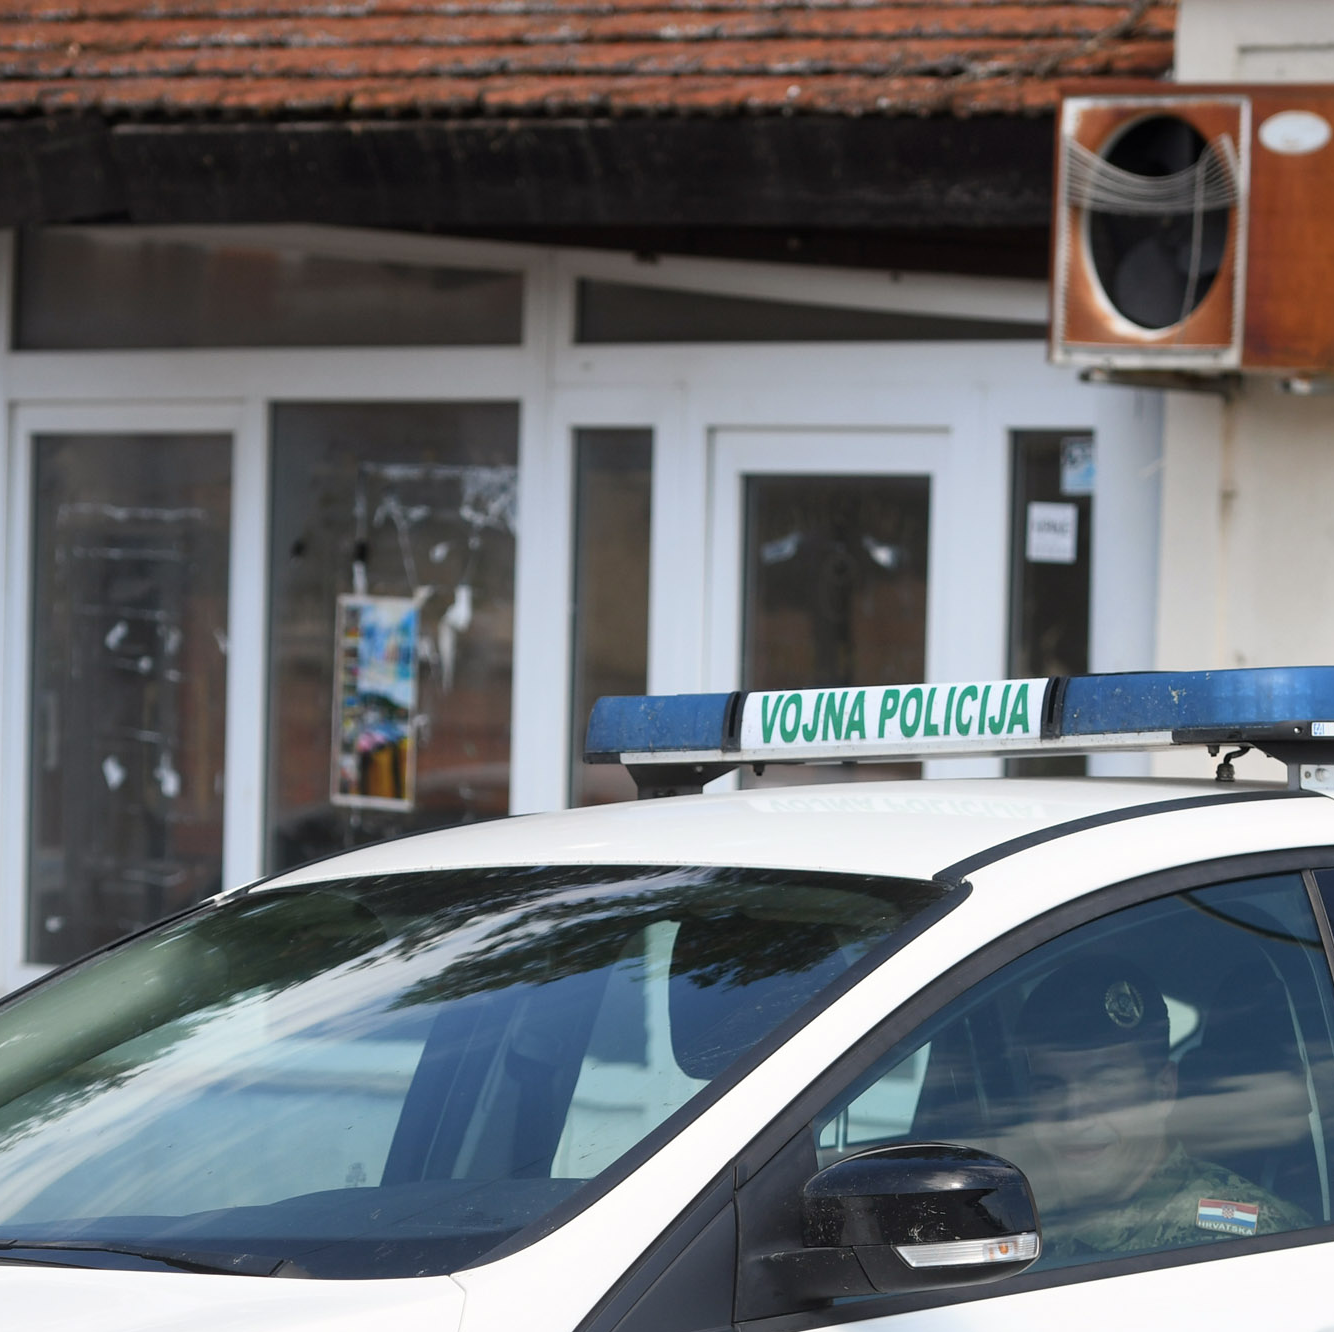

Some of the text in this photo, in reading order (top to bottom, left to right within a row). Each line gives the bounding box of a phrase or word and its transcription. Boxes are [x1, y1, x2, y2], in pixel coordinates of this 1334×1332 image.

[762, 683, 1030, 744] VOJNA POLICIJA
[1198, 1220, 1253, 1236] HRVATSKA
